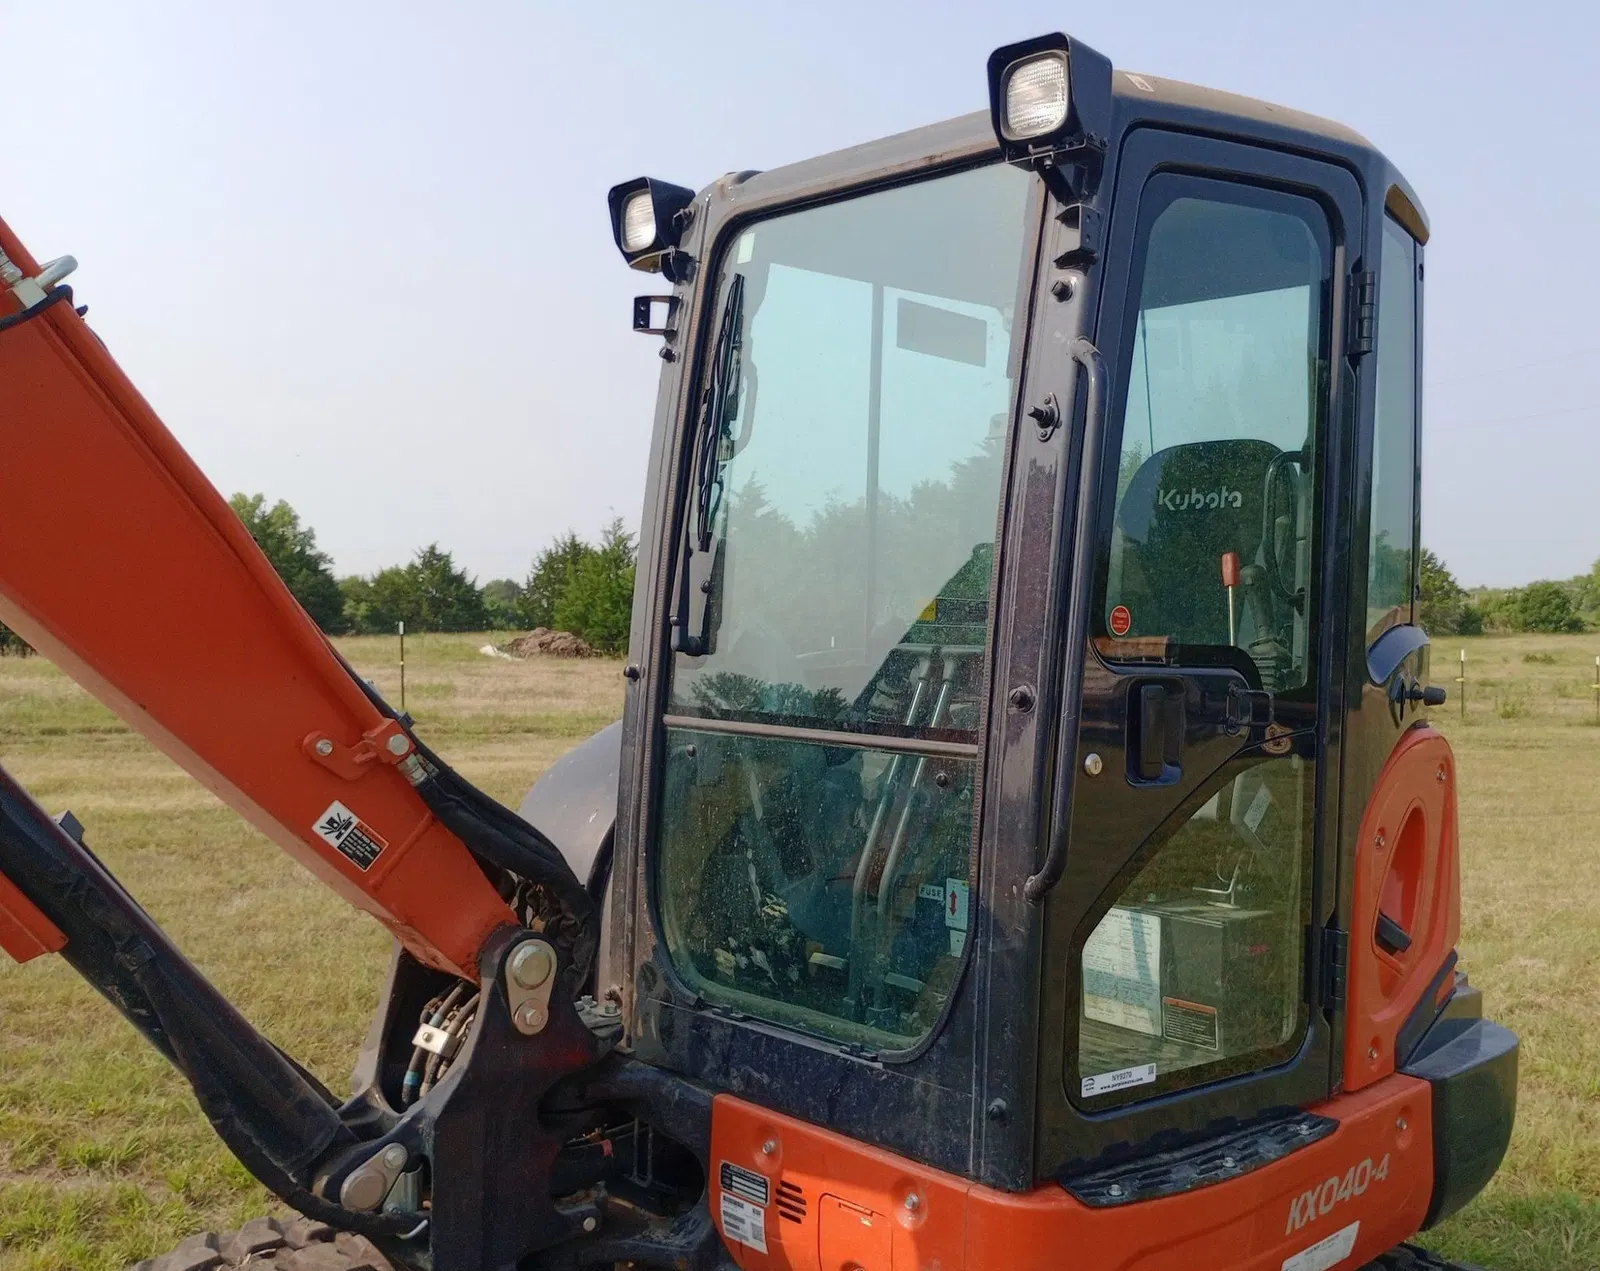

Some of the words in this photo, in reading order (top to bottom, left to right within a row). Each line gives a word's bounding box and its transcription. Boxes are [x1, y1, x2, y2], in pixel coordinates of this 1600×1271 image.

[1158, 485, 1242, 511] Kubota
[919, 887, 942, 898] FUSE
[1285, 1152, 1390, 1236] KX040-4
